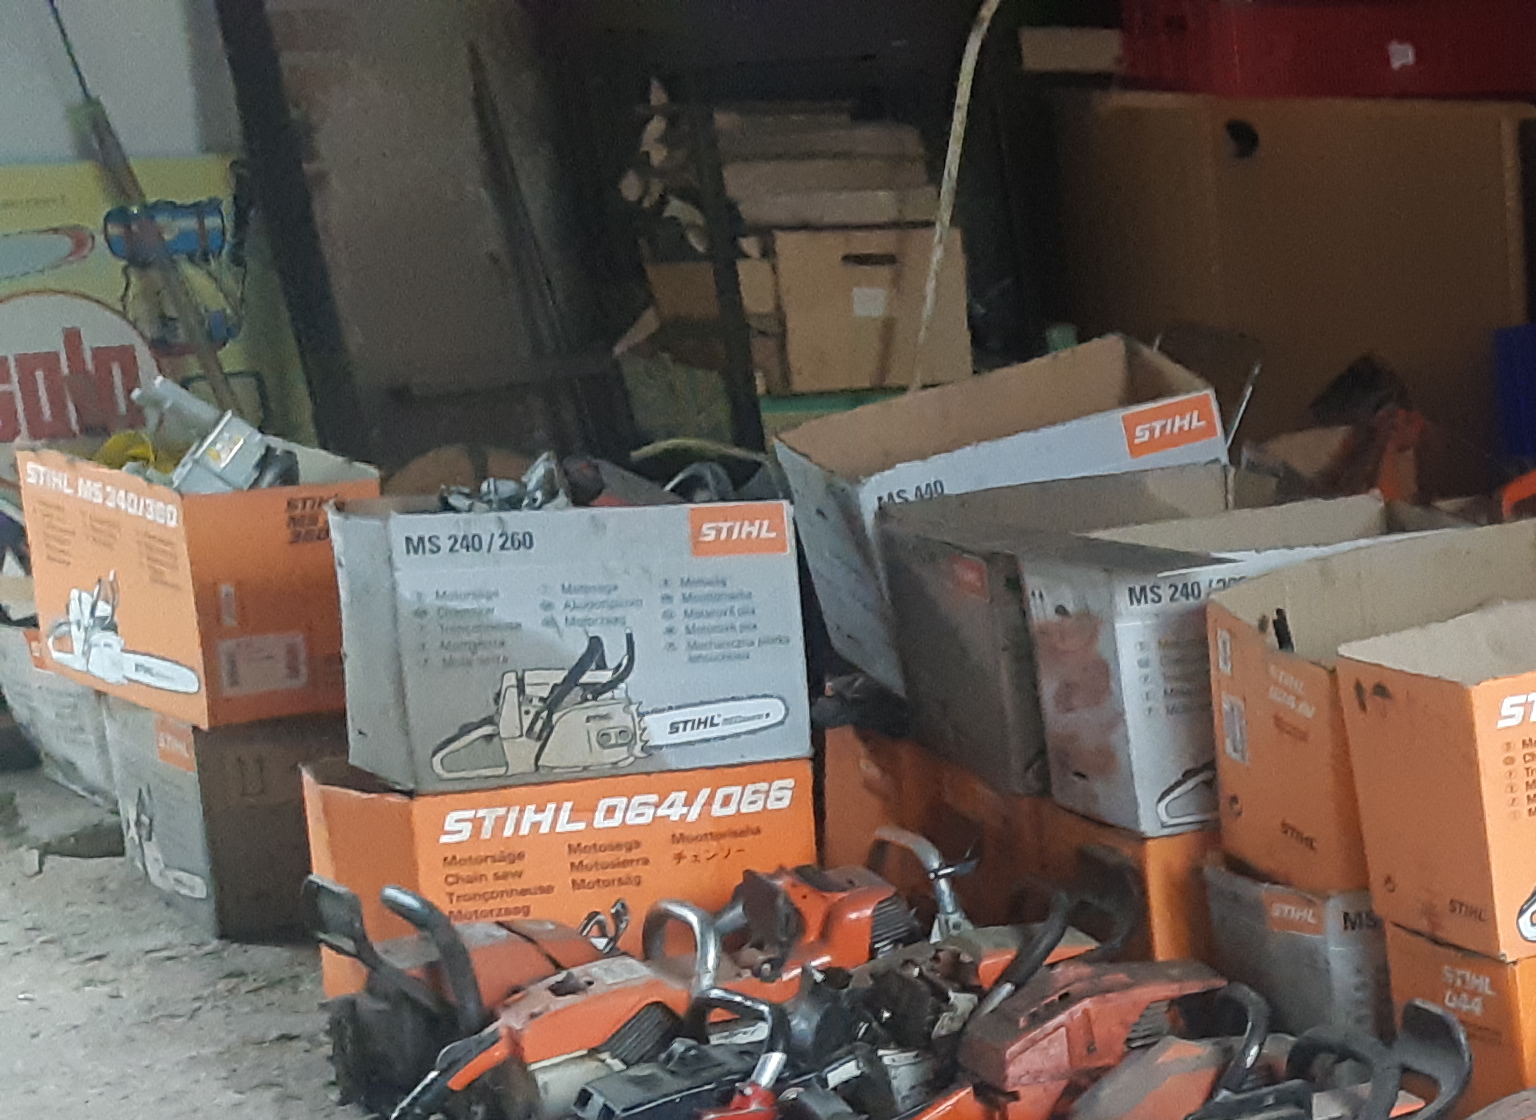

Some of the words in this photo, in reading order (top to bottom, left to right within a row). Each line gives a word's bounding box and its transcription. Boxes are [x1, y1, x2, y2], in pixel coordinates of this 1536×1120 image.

[1134, 410, 1207, 445] STIHL
[26, 461, 74, 494] STIHL
[78, 477, 103, 503] MS
[405, 535, 441, 555] MS
[448, 534, 484, 553] 240
[499, 531, 534, 551] 260
[700, 520, 777, 541] STIHL
[1128, 584, 1162, 606] MS
[1169, 580, 1202, 601] 240
[668, 714, 721, 735] STIHL
[439, 801, 586, 844] STIHL
[593, 779, 795, 829] 064/066
[1271, 903, 1317, 925] STIHL
[1449, 899, 1489, 922] STIHL
[1442, 965, 1496, 996] STIHL
